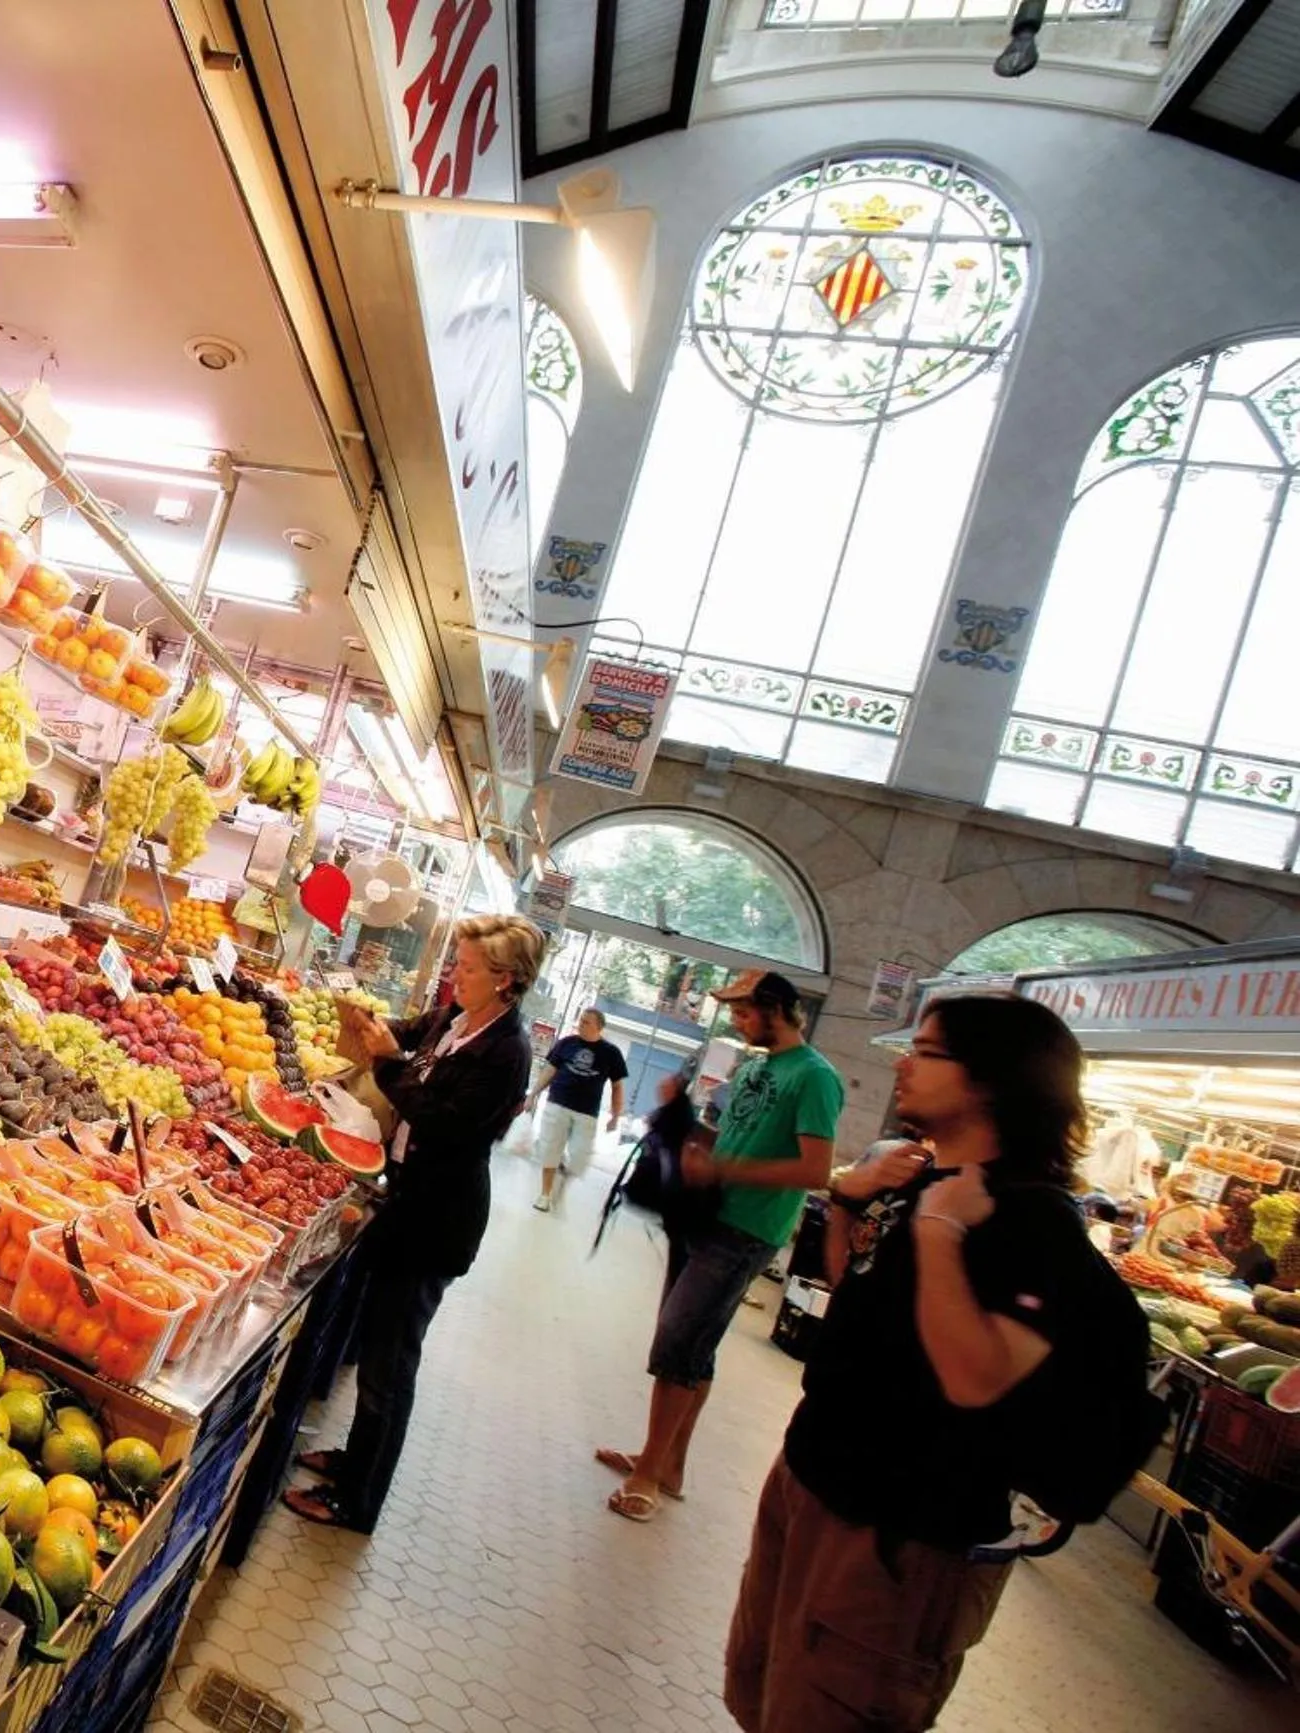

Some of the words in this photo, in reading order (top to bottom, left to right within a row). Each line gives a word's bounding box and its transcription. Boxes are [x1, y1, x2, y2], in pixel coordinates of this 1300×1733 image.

[591, 675, 665, 696] DOMICILIO
[1094, 975, 1205, 1019] FRUITES
[1209, 974, 1231, 1017] I
